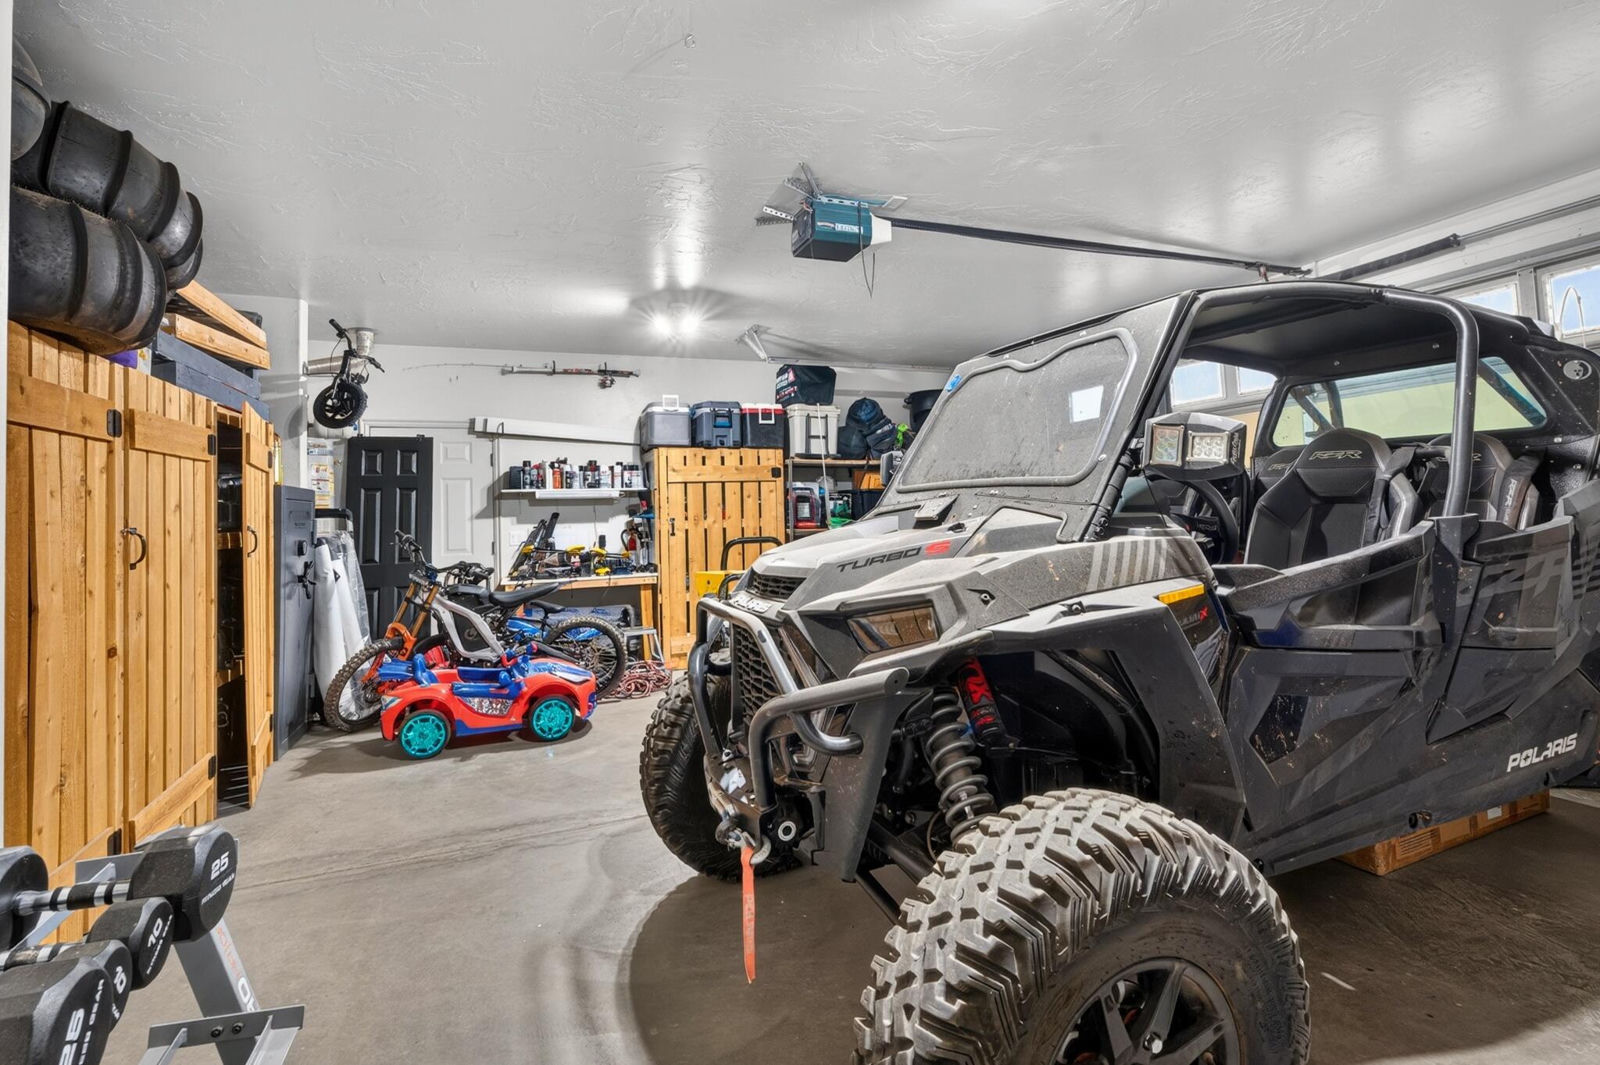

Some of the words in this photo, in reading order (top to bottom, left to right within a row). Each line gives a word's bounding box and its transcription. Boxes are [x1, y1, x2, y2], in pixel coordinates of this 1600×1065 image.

[836, 546, 921, 573] TURBO
[1506, 732, 1578, 773] POLARIS
[210, 851, 230, 881] 25
[147, 917, 164, 948] 10
[88, 979, 105, 1026] GEAR
